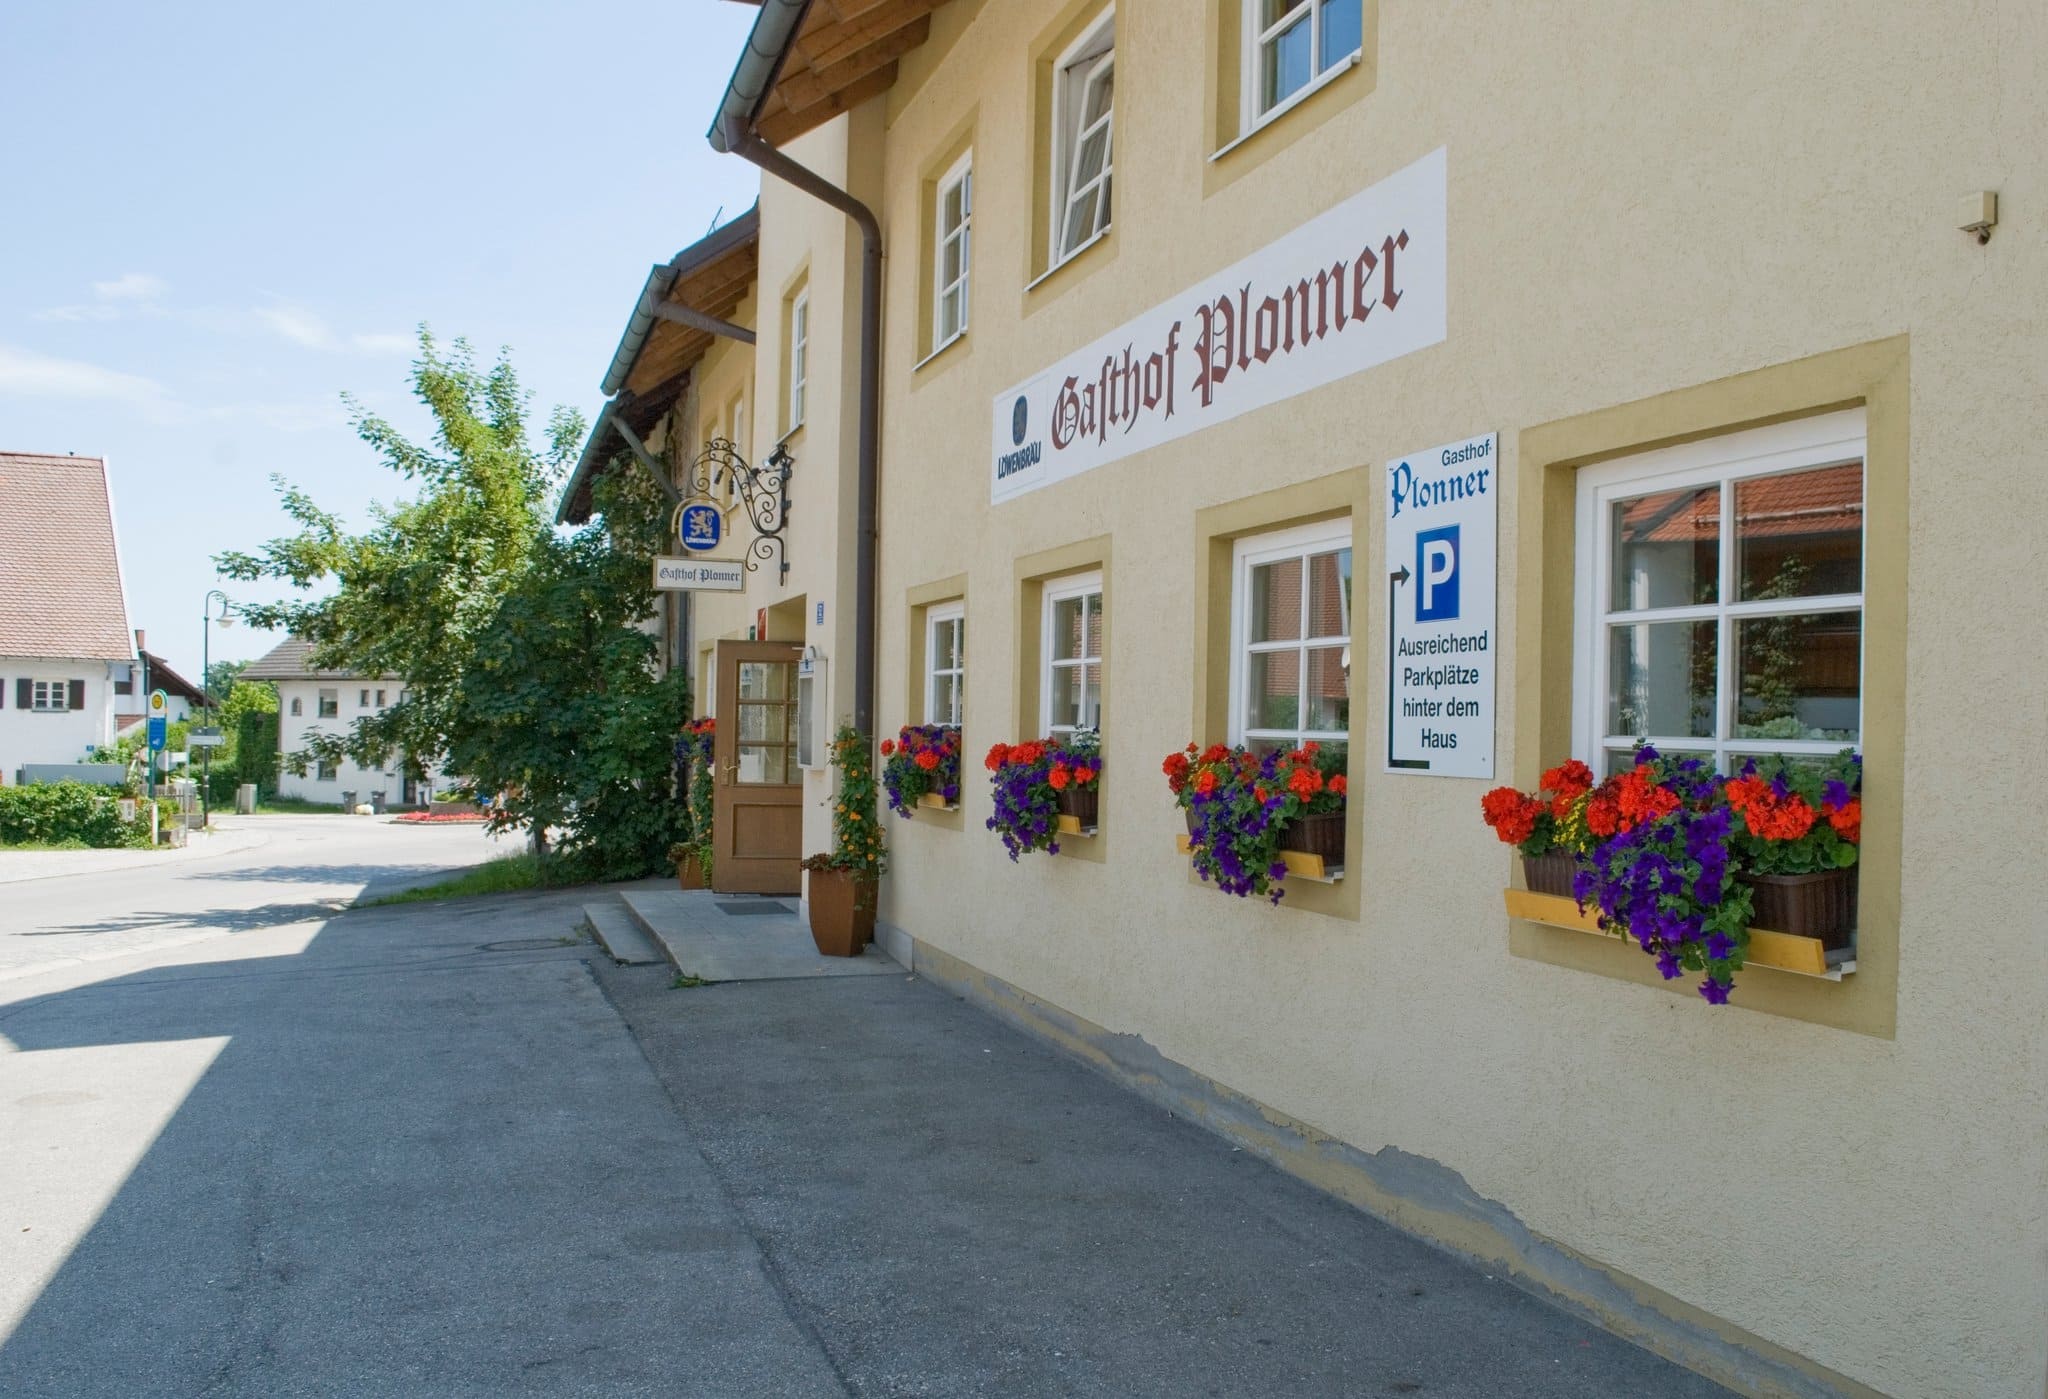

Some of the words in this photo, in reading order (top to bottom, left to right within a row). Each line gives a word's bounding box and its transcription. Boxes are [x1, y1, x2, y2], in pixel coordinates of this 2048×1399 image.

[1191, 228, 1410, 408] Plonner
[1441, 438, 1491, 467] Gasthof
[1391, 461, 1490, 519] Plonner
[700, 568, 740, 582] Plonner
[1422, 539, 1455, 611] P
[1398, 630, 1488, 657] Ausreichend
[1403, 665, 1480, 690] Parkplätze
[1403, 697, 1442, 718] hinter
[1446, 696, 1480, 717] dem
[1421, 728, 1458, 749] Haus
